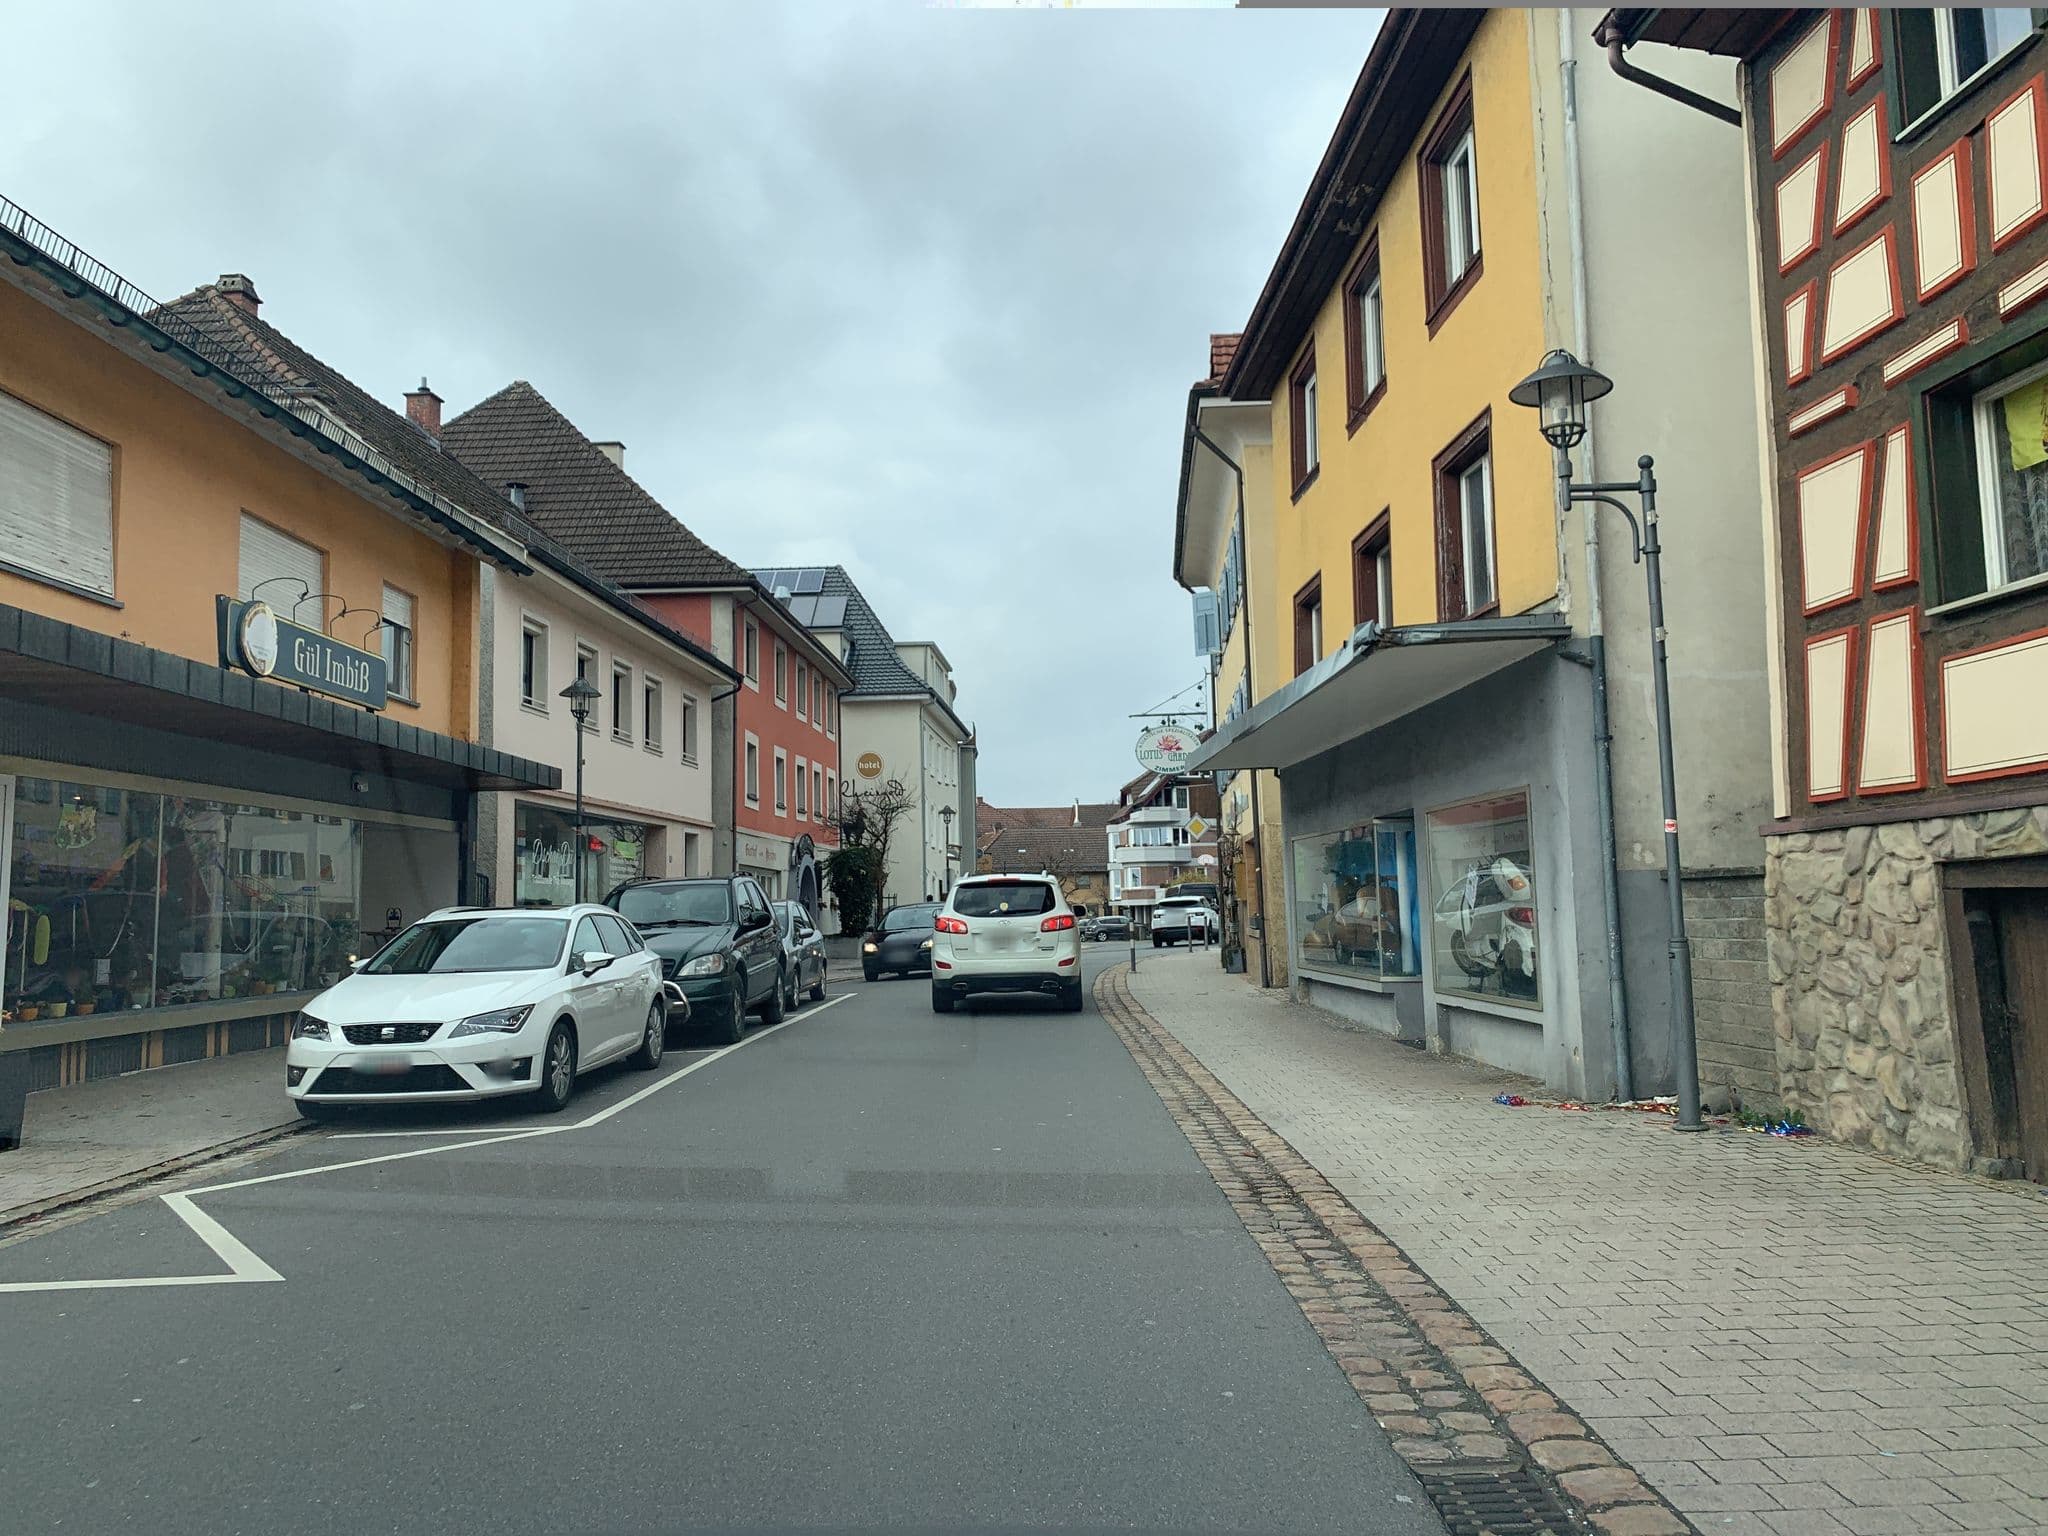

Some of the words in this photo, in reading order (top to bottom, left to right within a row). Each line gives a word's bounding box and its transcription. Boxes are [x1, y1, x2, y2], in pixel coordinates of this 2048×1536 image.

[294, 638, 320, 678] Gül
[325, 648, 369, 693] Imbiß
[1140, 750, 1163, 760] LOTUS
[859, 760, 880, 769] hotel
